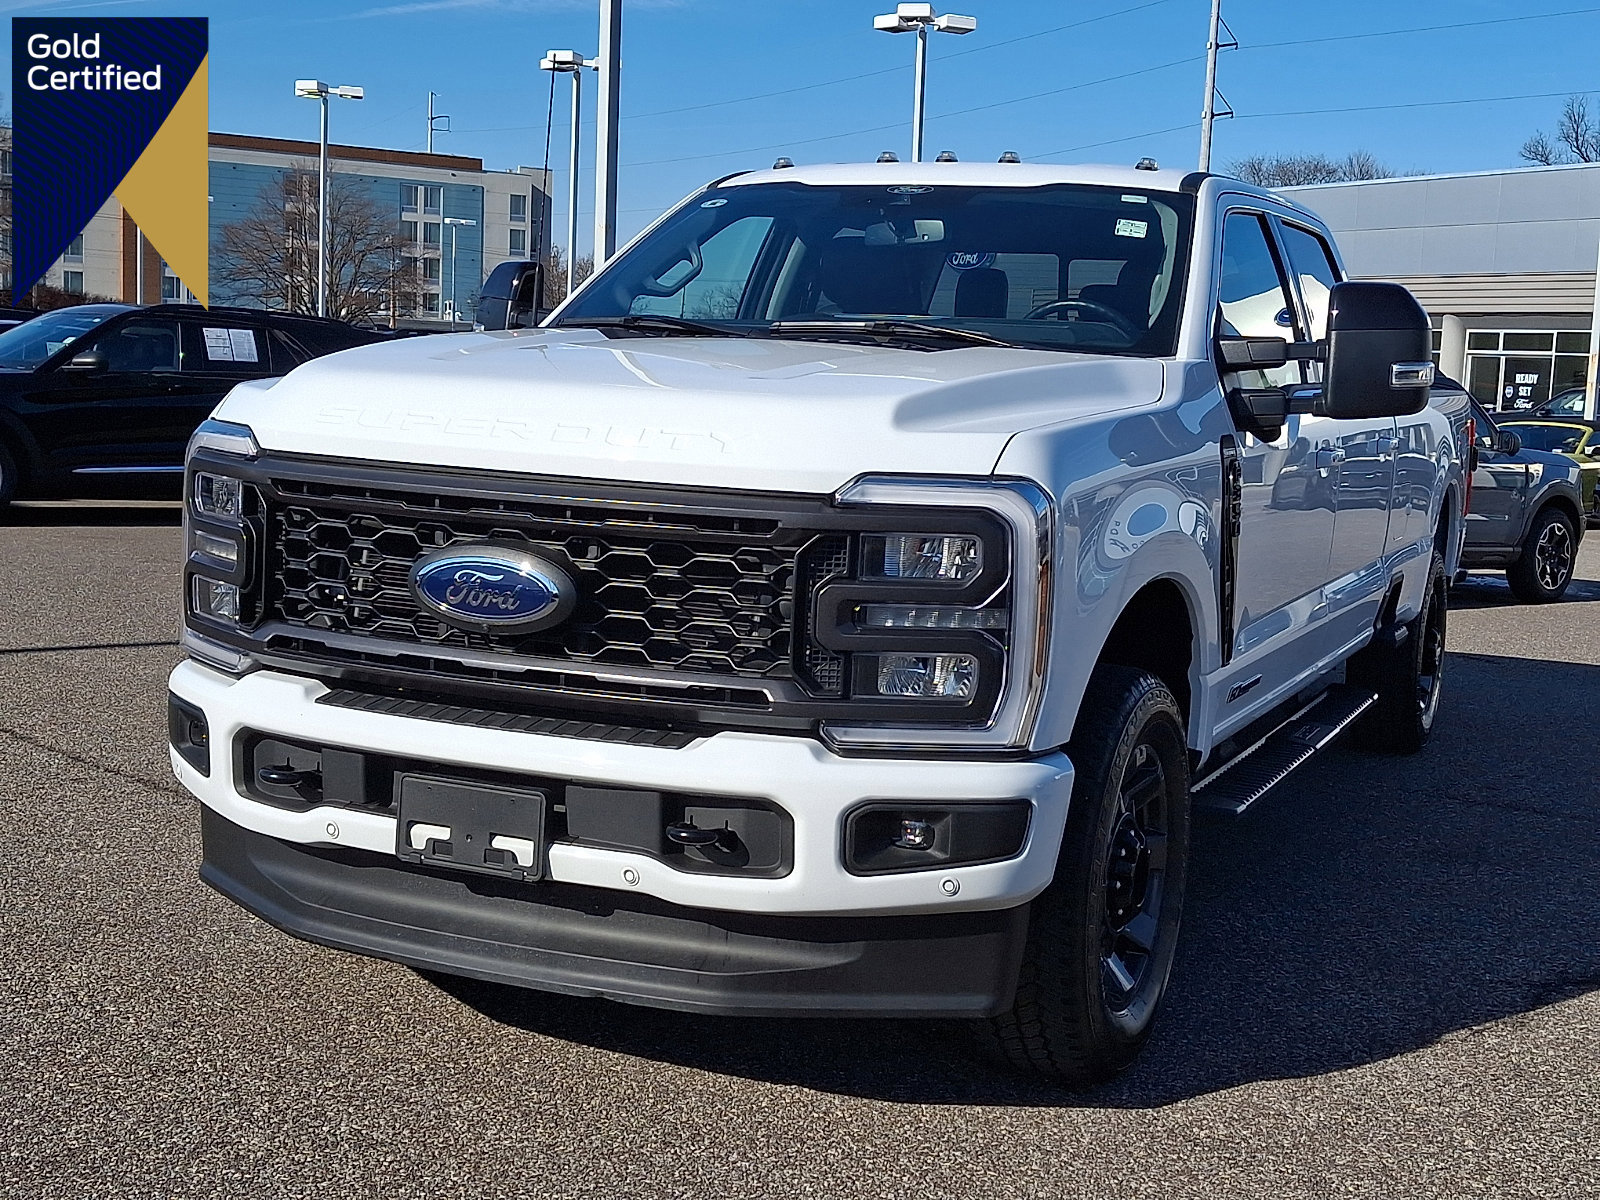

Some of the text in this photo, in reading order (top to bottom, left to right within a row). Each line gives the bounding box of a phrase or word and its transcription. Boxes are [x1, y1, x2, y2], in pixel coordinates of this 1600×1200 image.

[952, 252, 979, 265] Ford
[1515, 373, 1539, 384] READY
[1518, 386, 1532, 396] SET
[1514, 398, 1535, 408] Ford
[315, 407, 740, 454] SUPER DUTY
[445, 569, 524, 611] Ford
